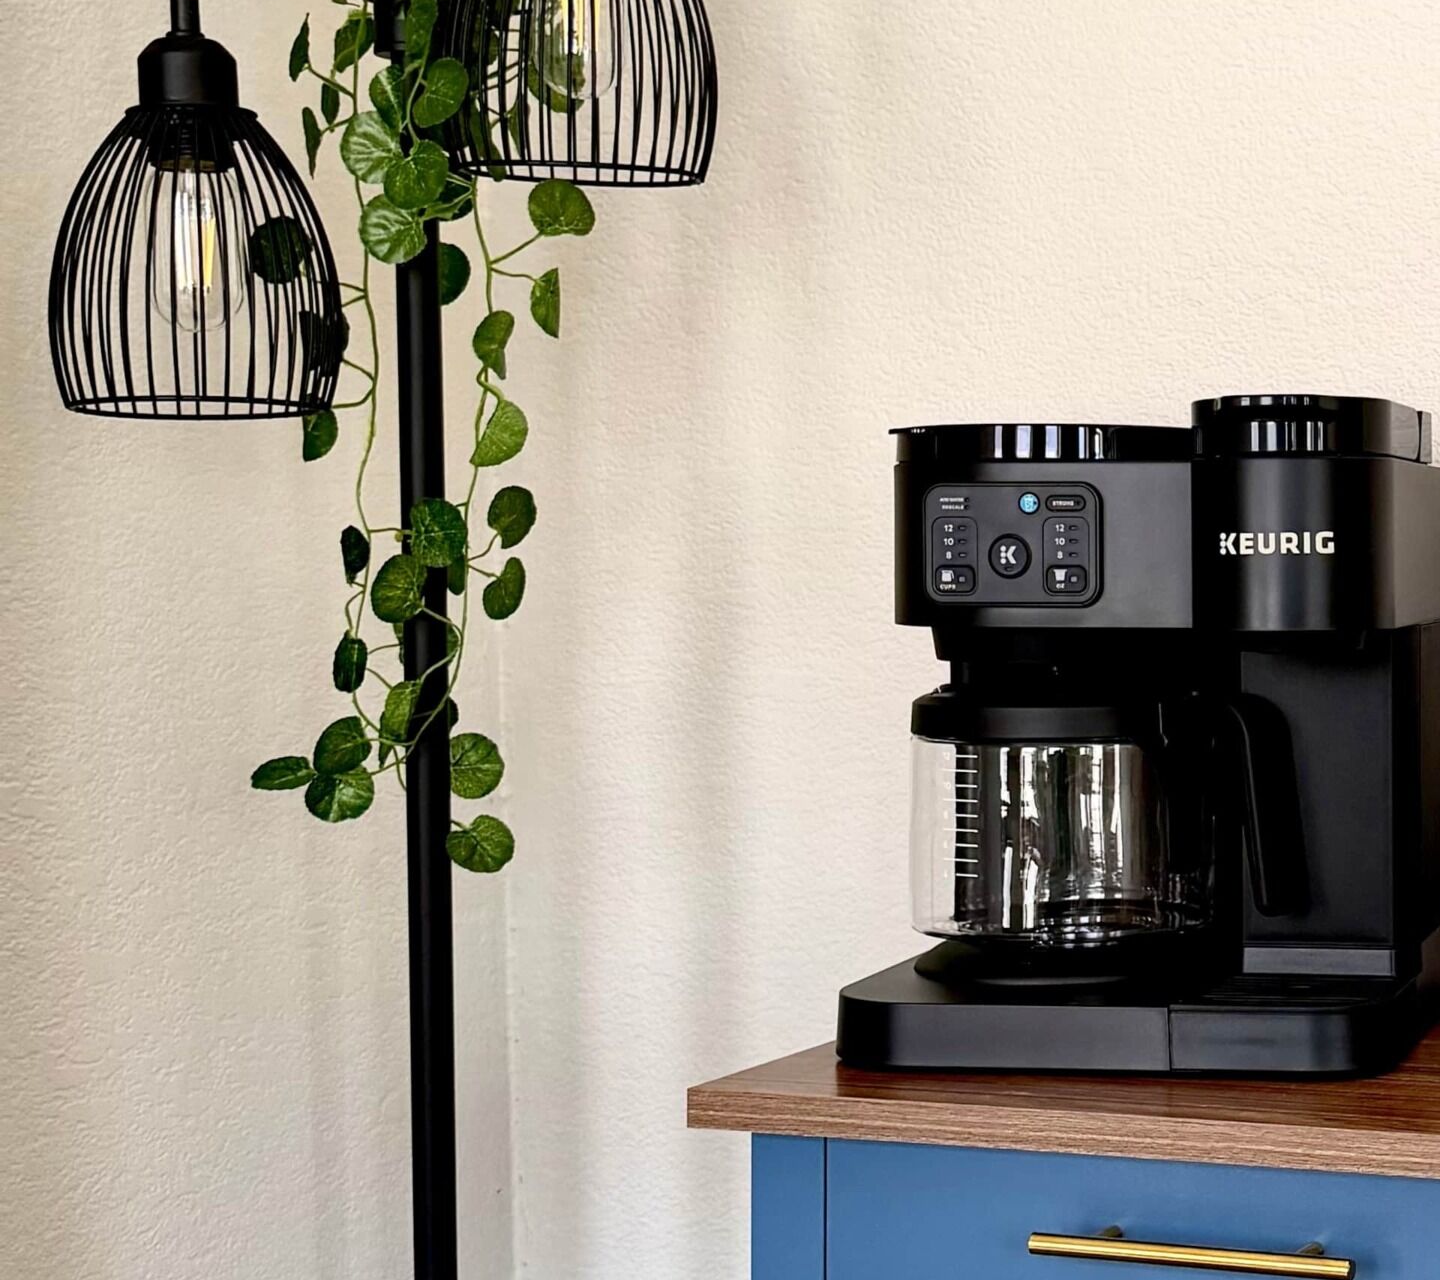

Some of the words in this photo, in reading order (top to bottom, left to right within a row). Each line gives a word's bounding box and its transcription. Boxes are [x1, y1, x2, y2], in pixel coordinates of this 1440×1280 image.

[944, 524, 953, 532] 12
[1055, 524, 1065, 532] 12
[943, 538, 954, 546] 10
[1054, 538, 1065, 546] 10
[1219, 531, 1335, 555] KEURIG
[945, 551, 952, 559] 8
[1057, 551, 1063, 559] 8
